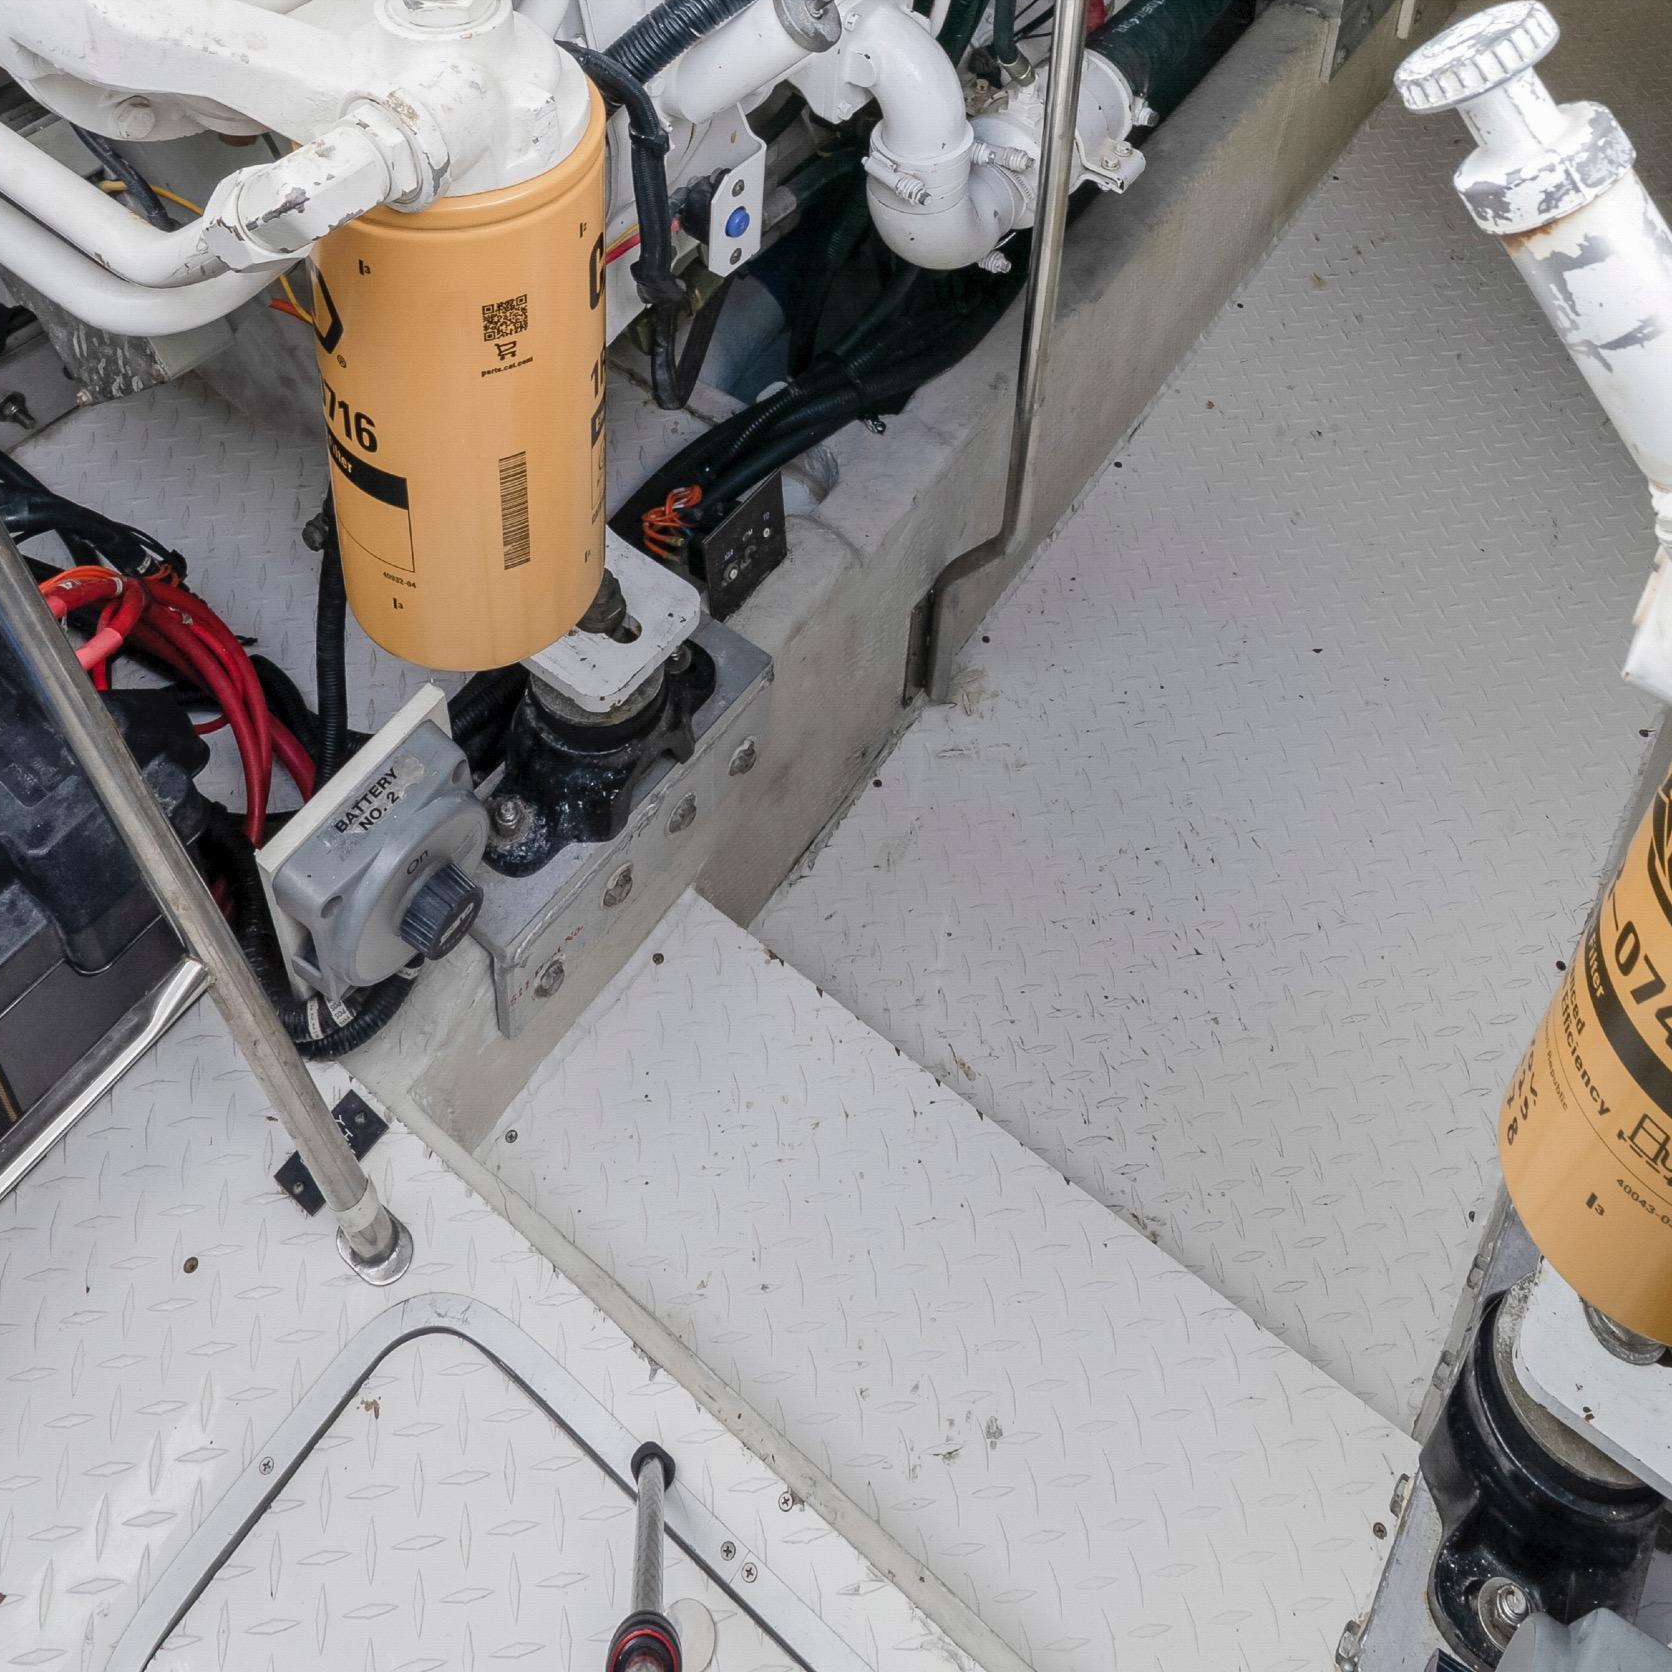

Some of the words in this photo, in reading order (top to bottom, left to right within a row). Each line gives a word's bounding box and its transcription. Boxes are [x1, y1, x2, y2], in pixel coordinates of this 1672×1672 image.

[481, 356, 534, 378] parts.cat.com
[334, 767, 398, 833] BATTERY
[359, 806, 388, 831] NO.
[387, 790, 400, 805] 2
[406, 850, 429, 875] On
[1560, 992, 1611, 1116] Efficiency
